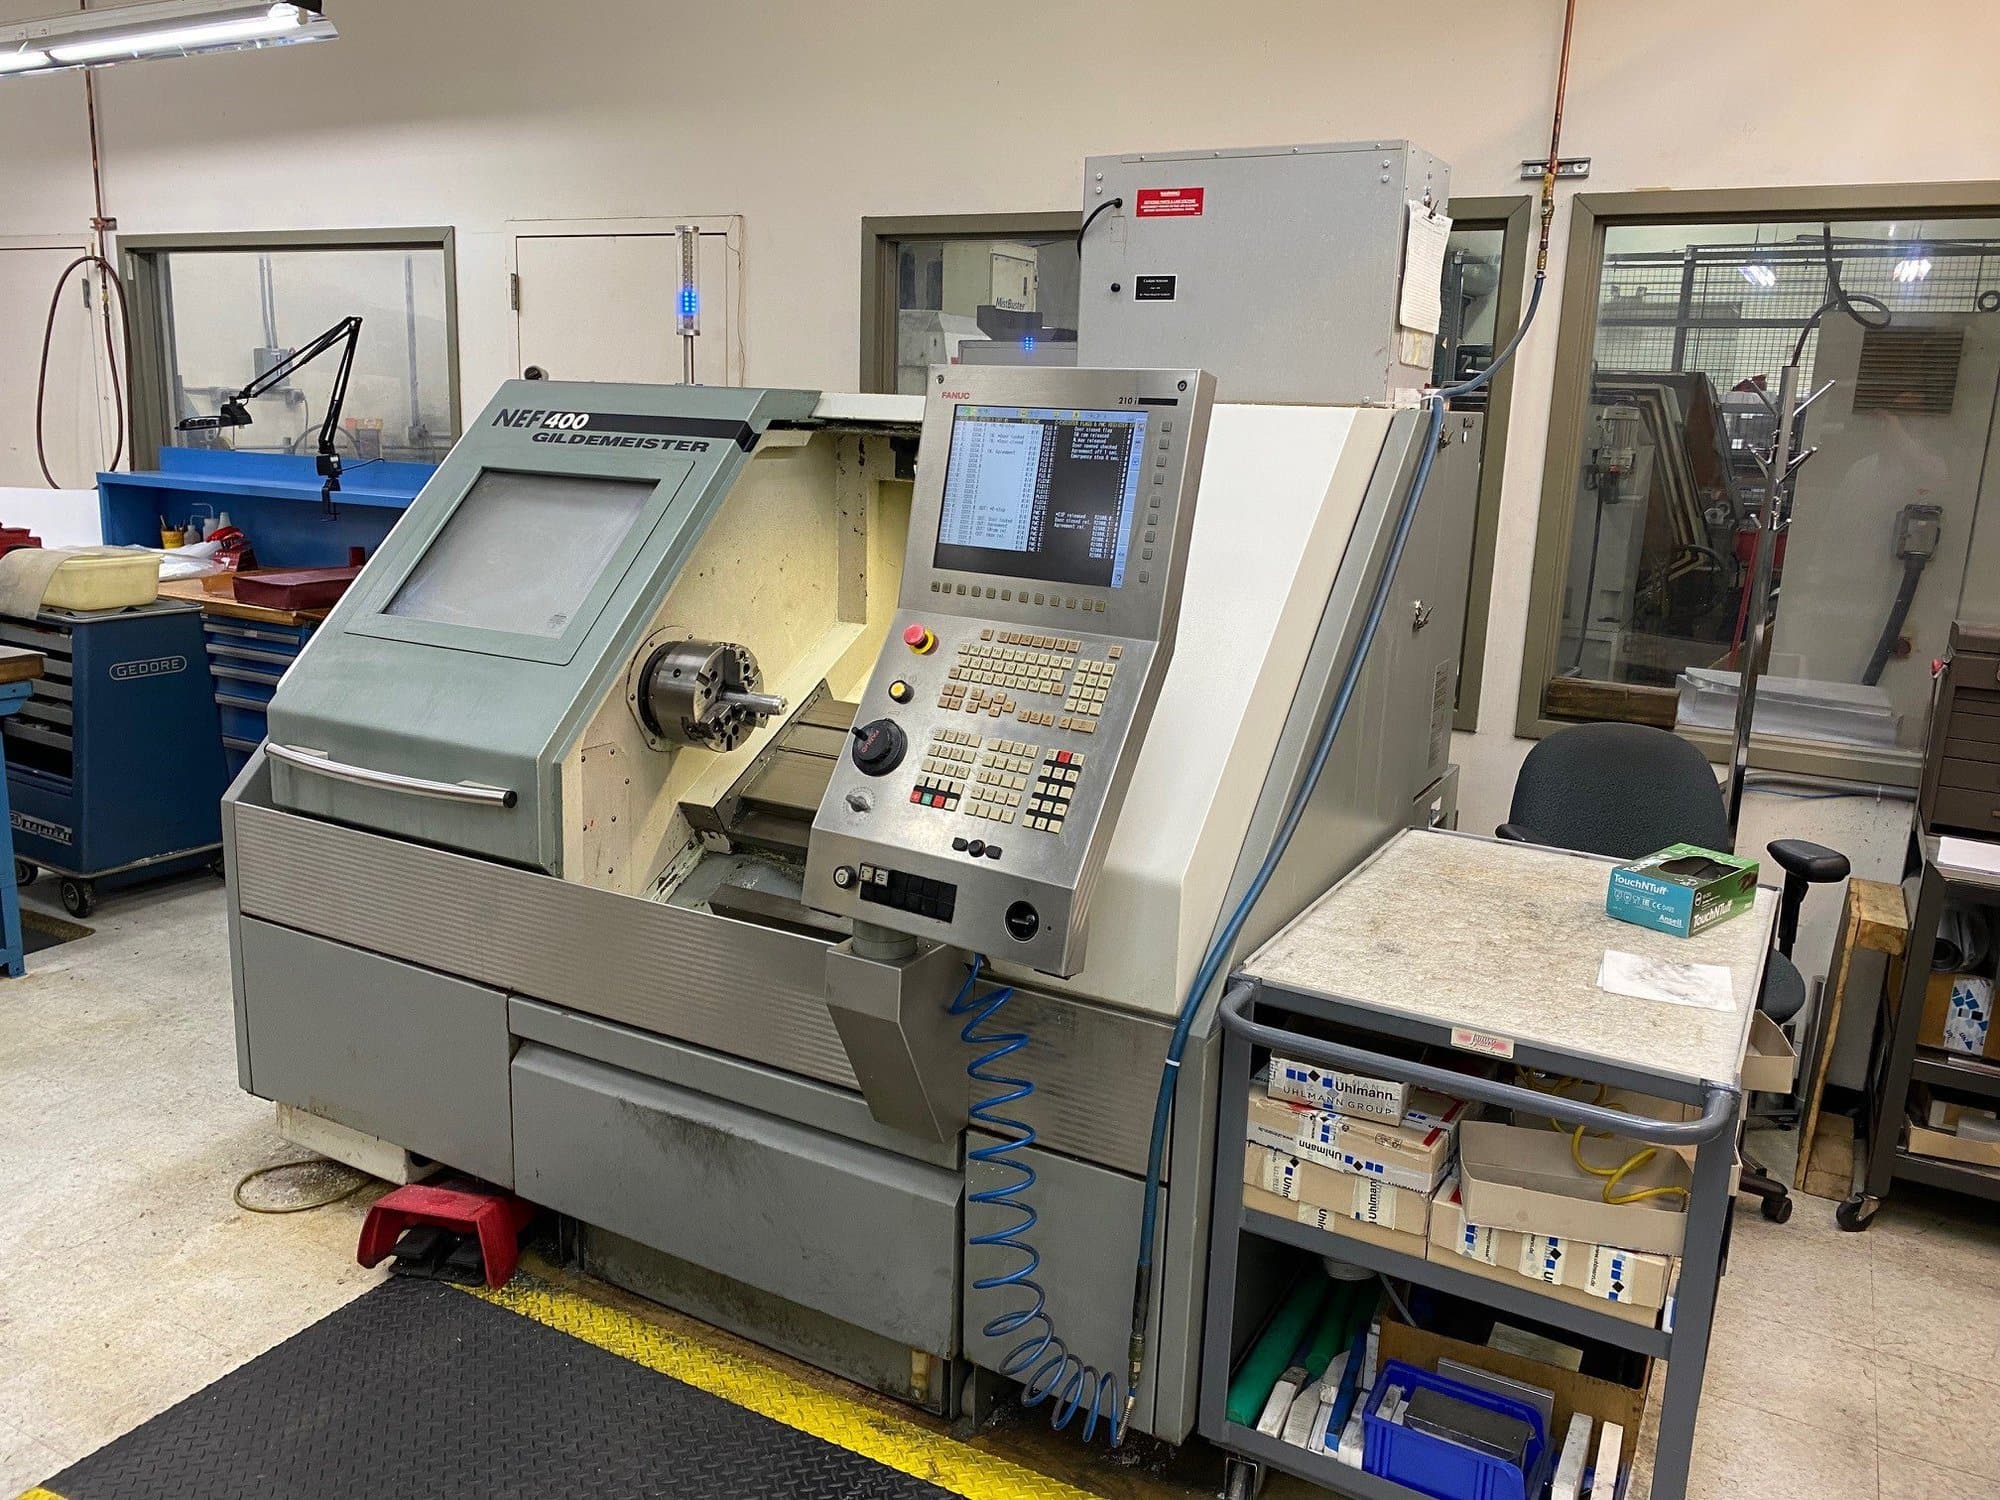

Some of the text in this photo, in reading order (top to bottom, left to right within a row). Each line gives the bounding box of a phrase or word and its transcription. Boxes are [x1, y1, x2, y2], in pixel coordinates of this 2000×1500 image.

[996, 297, 1025, 310] MistBuster
[942, 392, 970, 400] FANUC
[492, 409, 590, 430] NEF 400
[532, 433, 710, 452] GILDEMEISTER
[117, 658, 180, 676] GEDORE
[1614, 873, 1667, 895] TouchNTuff
[1658, 914, 1684, 927] Ansell
[1694, 899, 1732, 928] TouchNTuff
[1335, 1081, 1393, 1100] Uhlmann
[1283, 1086, 1392, 1115] UHLMANN GROUP
[1299, 1140, 1342, 1160] Uhlmann
